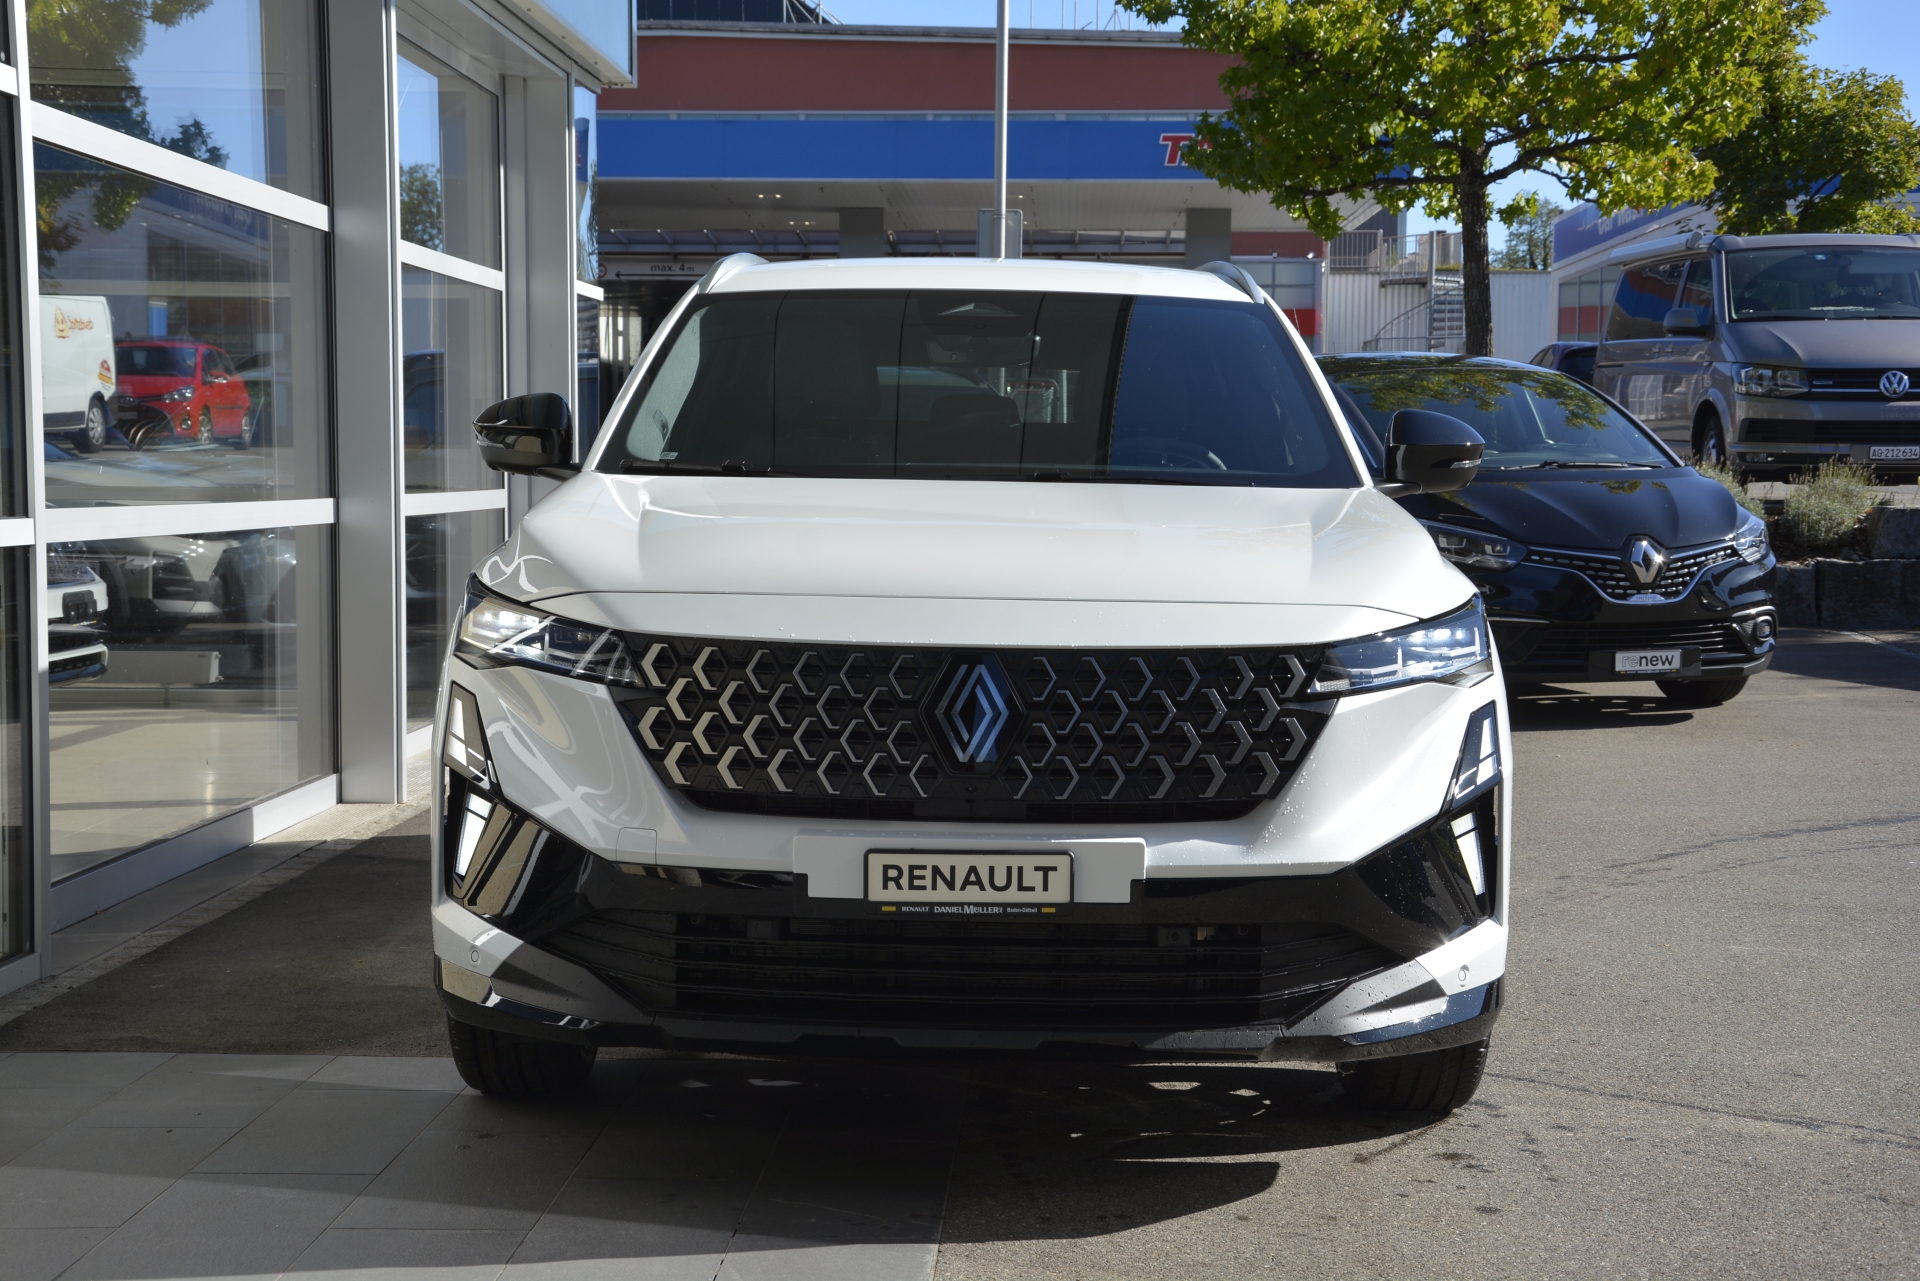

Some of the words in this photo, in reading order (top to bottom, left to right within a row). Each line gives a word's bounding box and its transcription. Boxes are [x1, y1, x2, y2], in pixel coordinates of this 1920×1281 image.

[650, 264, 676, 272] max.
[1621, 654, 1675, 668] renew
[882, 864, 1058, 892] RENAULT
